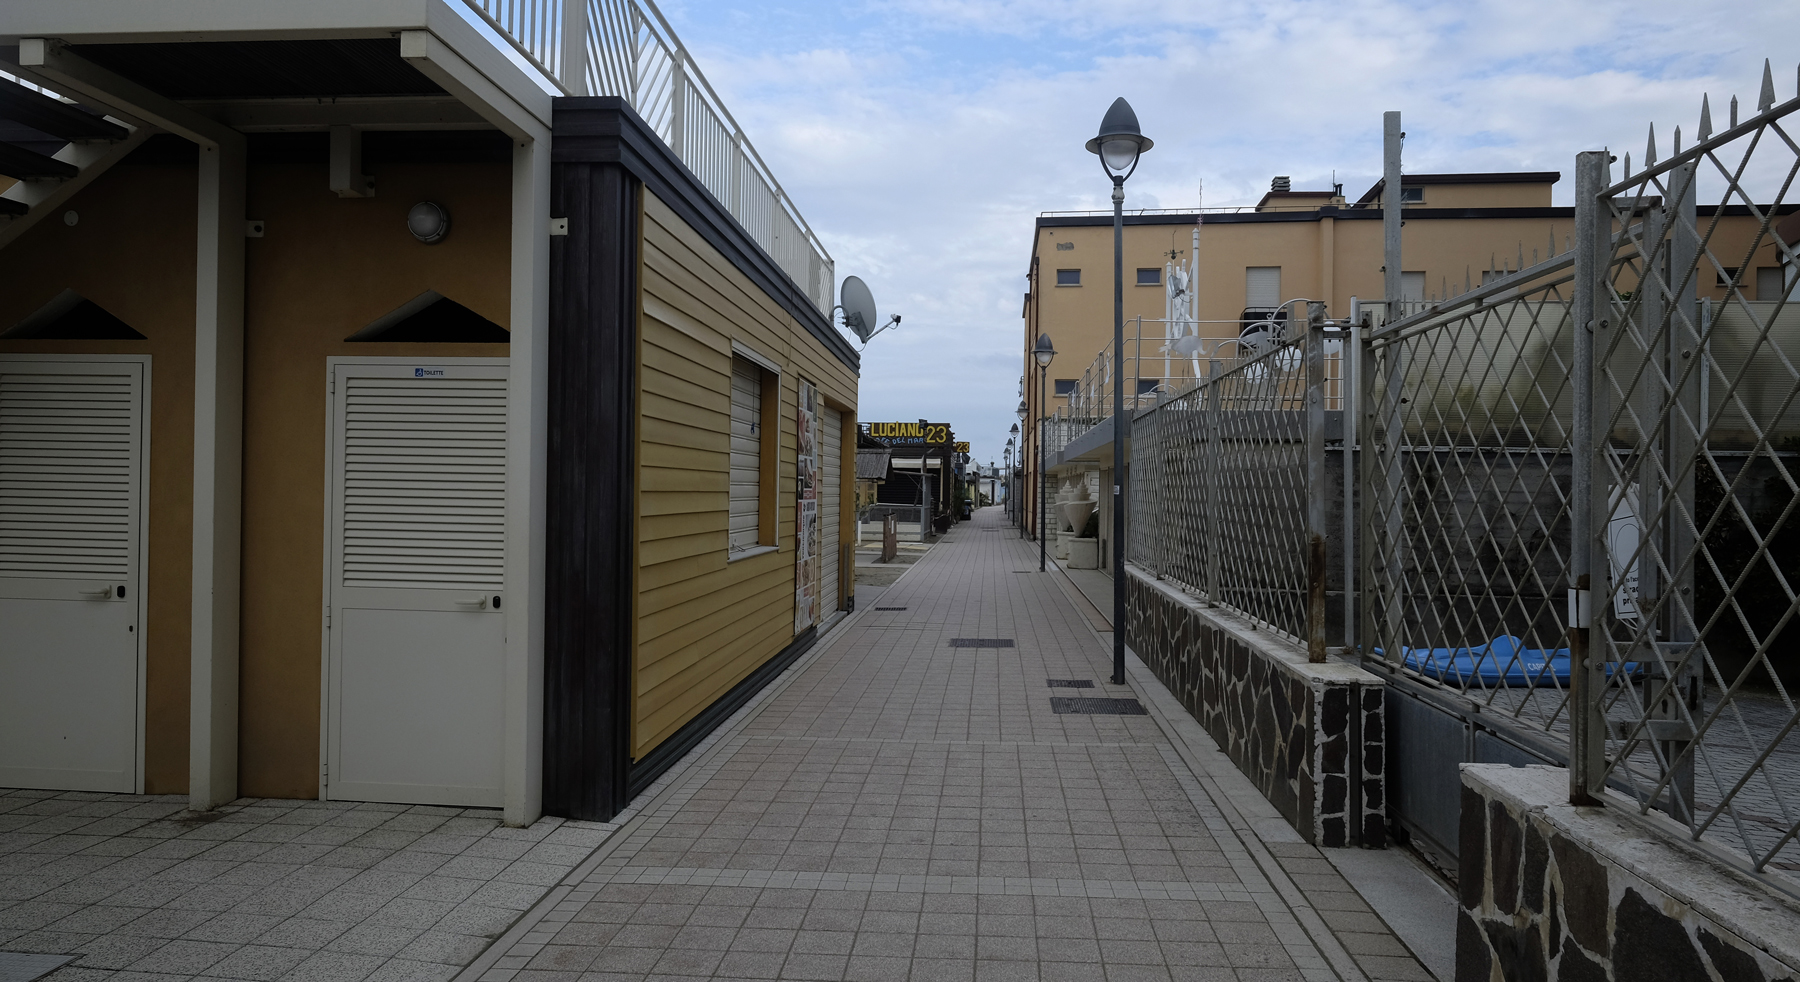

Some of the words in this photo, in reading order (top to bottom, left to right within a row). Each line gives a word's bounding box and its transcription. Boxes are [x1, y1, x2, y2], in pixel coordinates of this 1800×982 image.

[871, 421, 924, 437] LUCIANO
[926, 426, 947, 443] 23
[957, 442, 969, 452] 23
